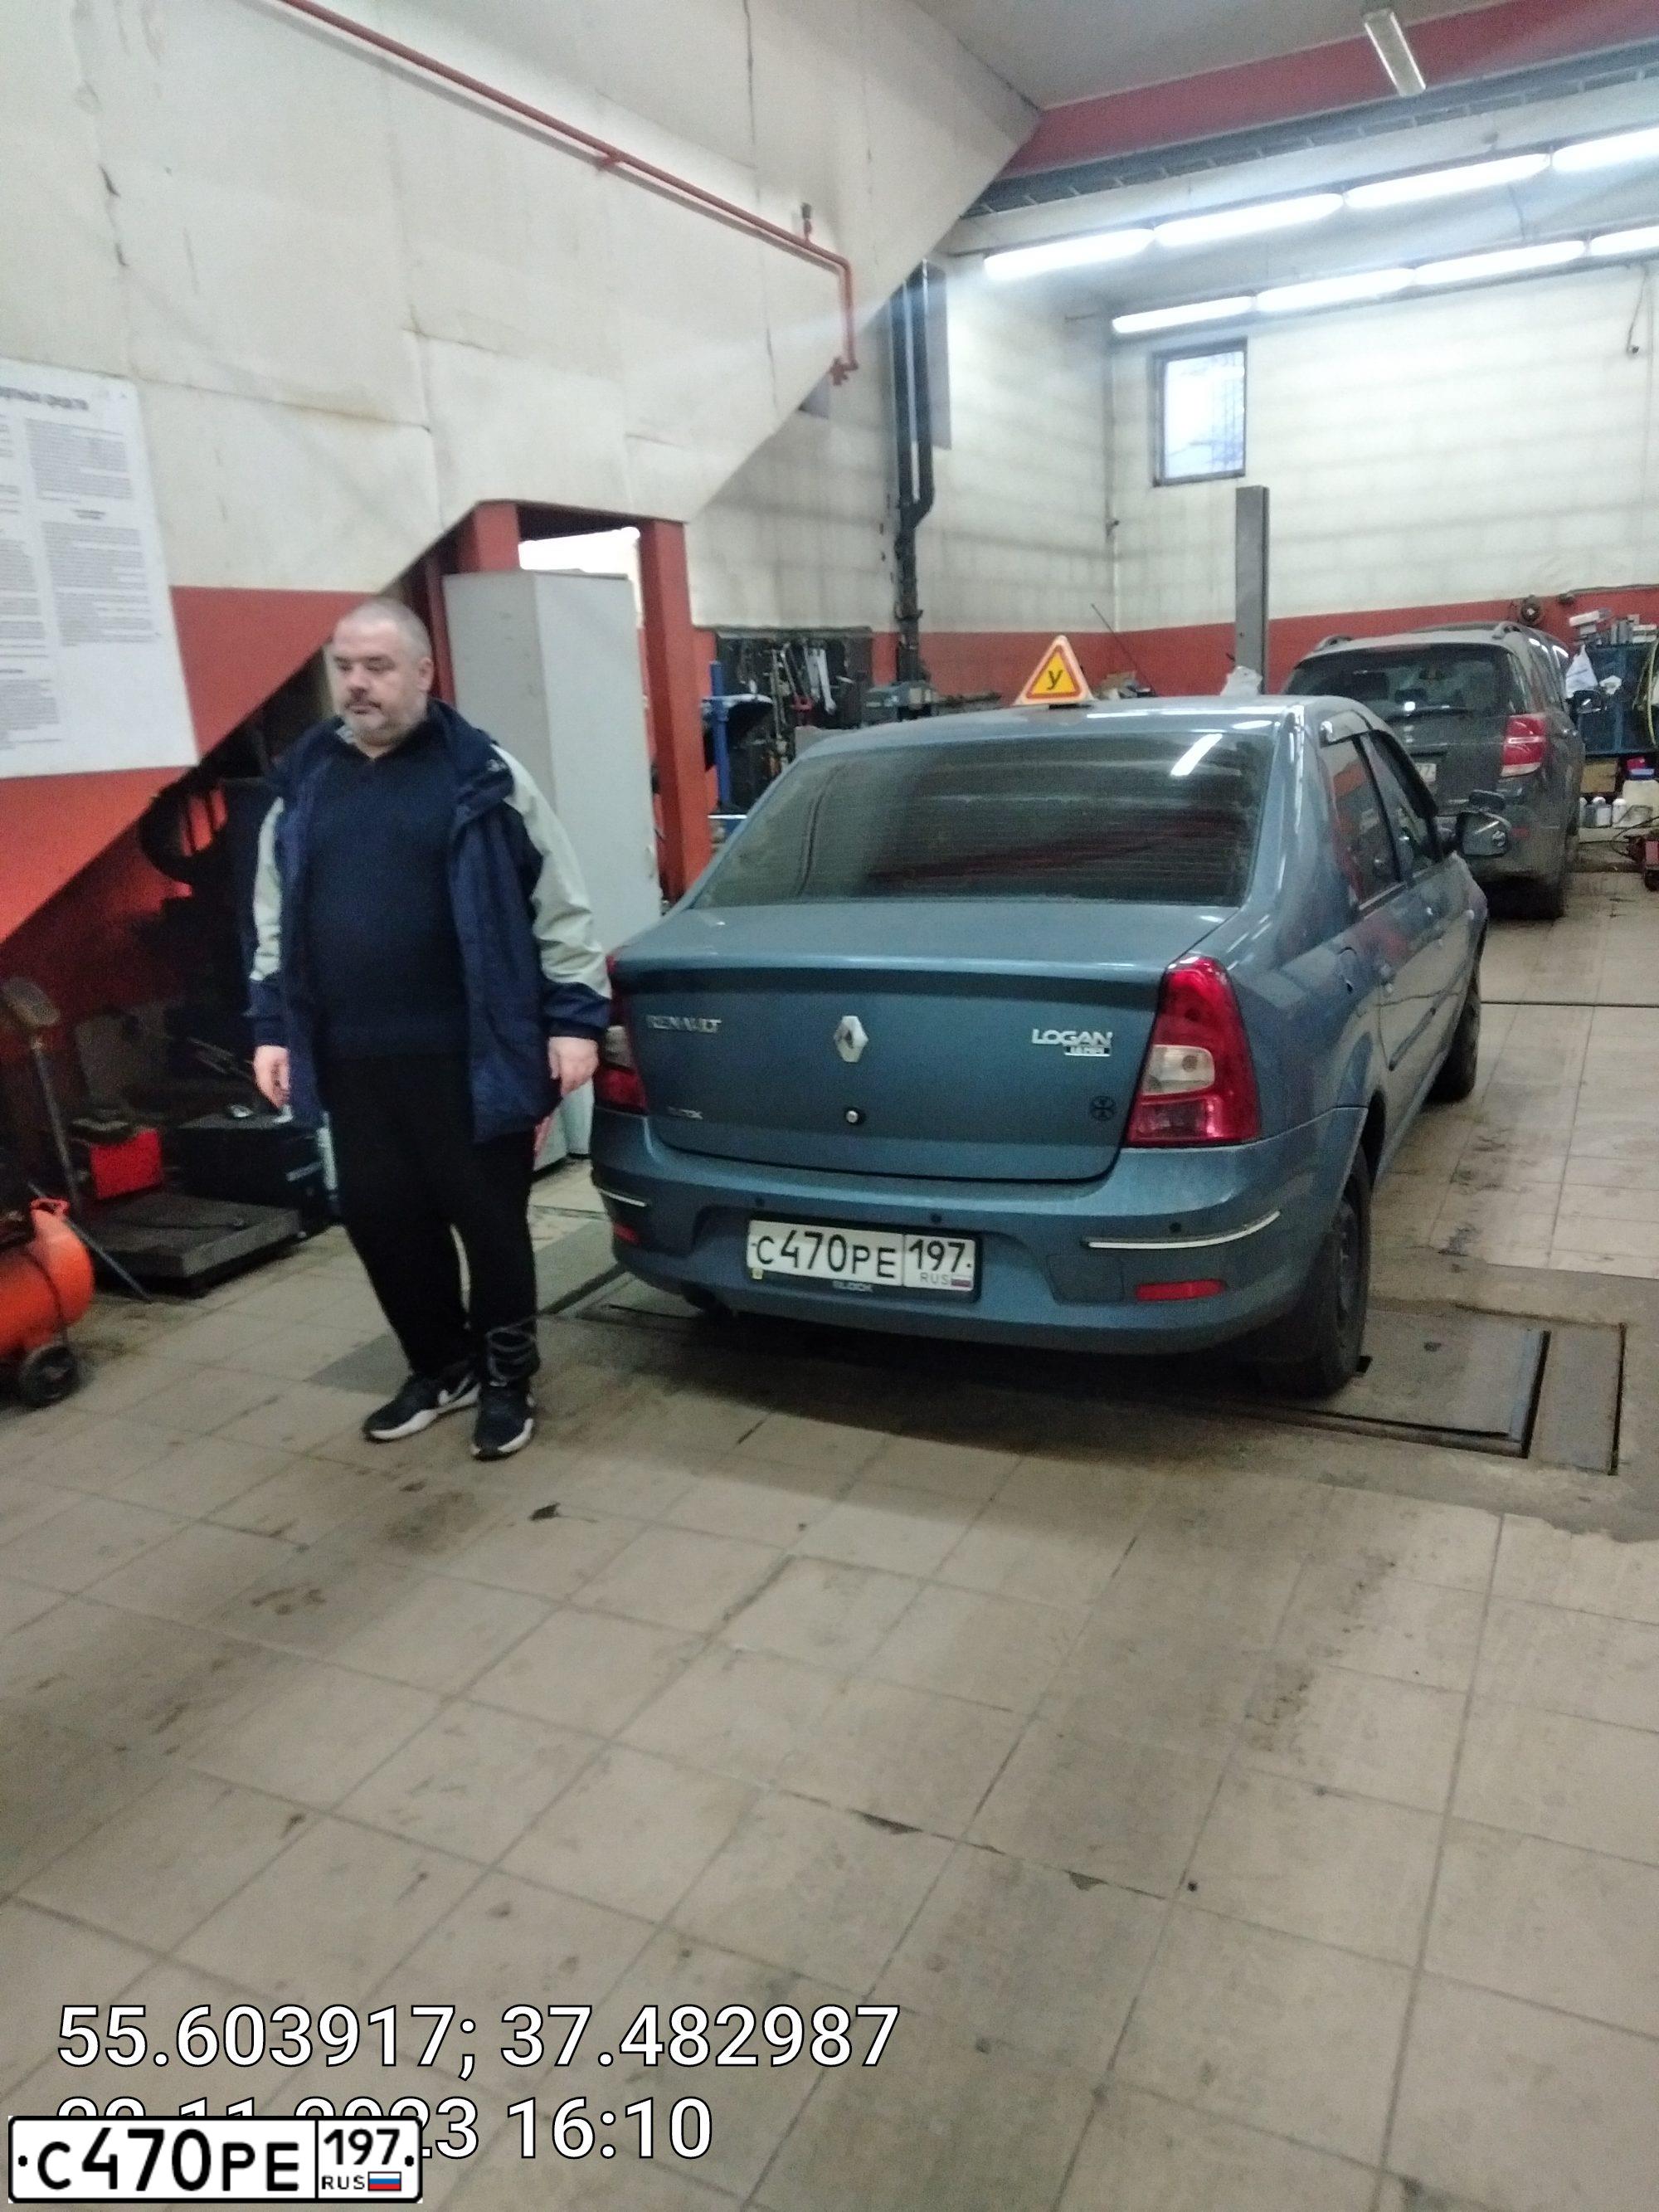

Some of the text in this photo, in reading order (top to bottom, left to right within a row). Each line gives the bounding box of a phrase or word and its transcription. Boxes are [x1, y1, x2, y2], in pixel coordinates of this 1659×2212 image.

[1032, 1029, 1113, 1046] LOGAN
[756, 1229, 966, 1279] С470РЕ 197
[919, 1271, 951, 1285] RUS
